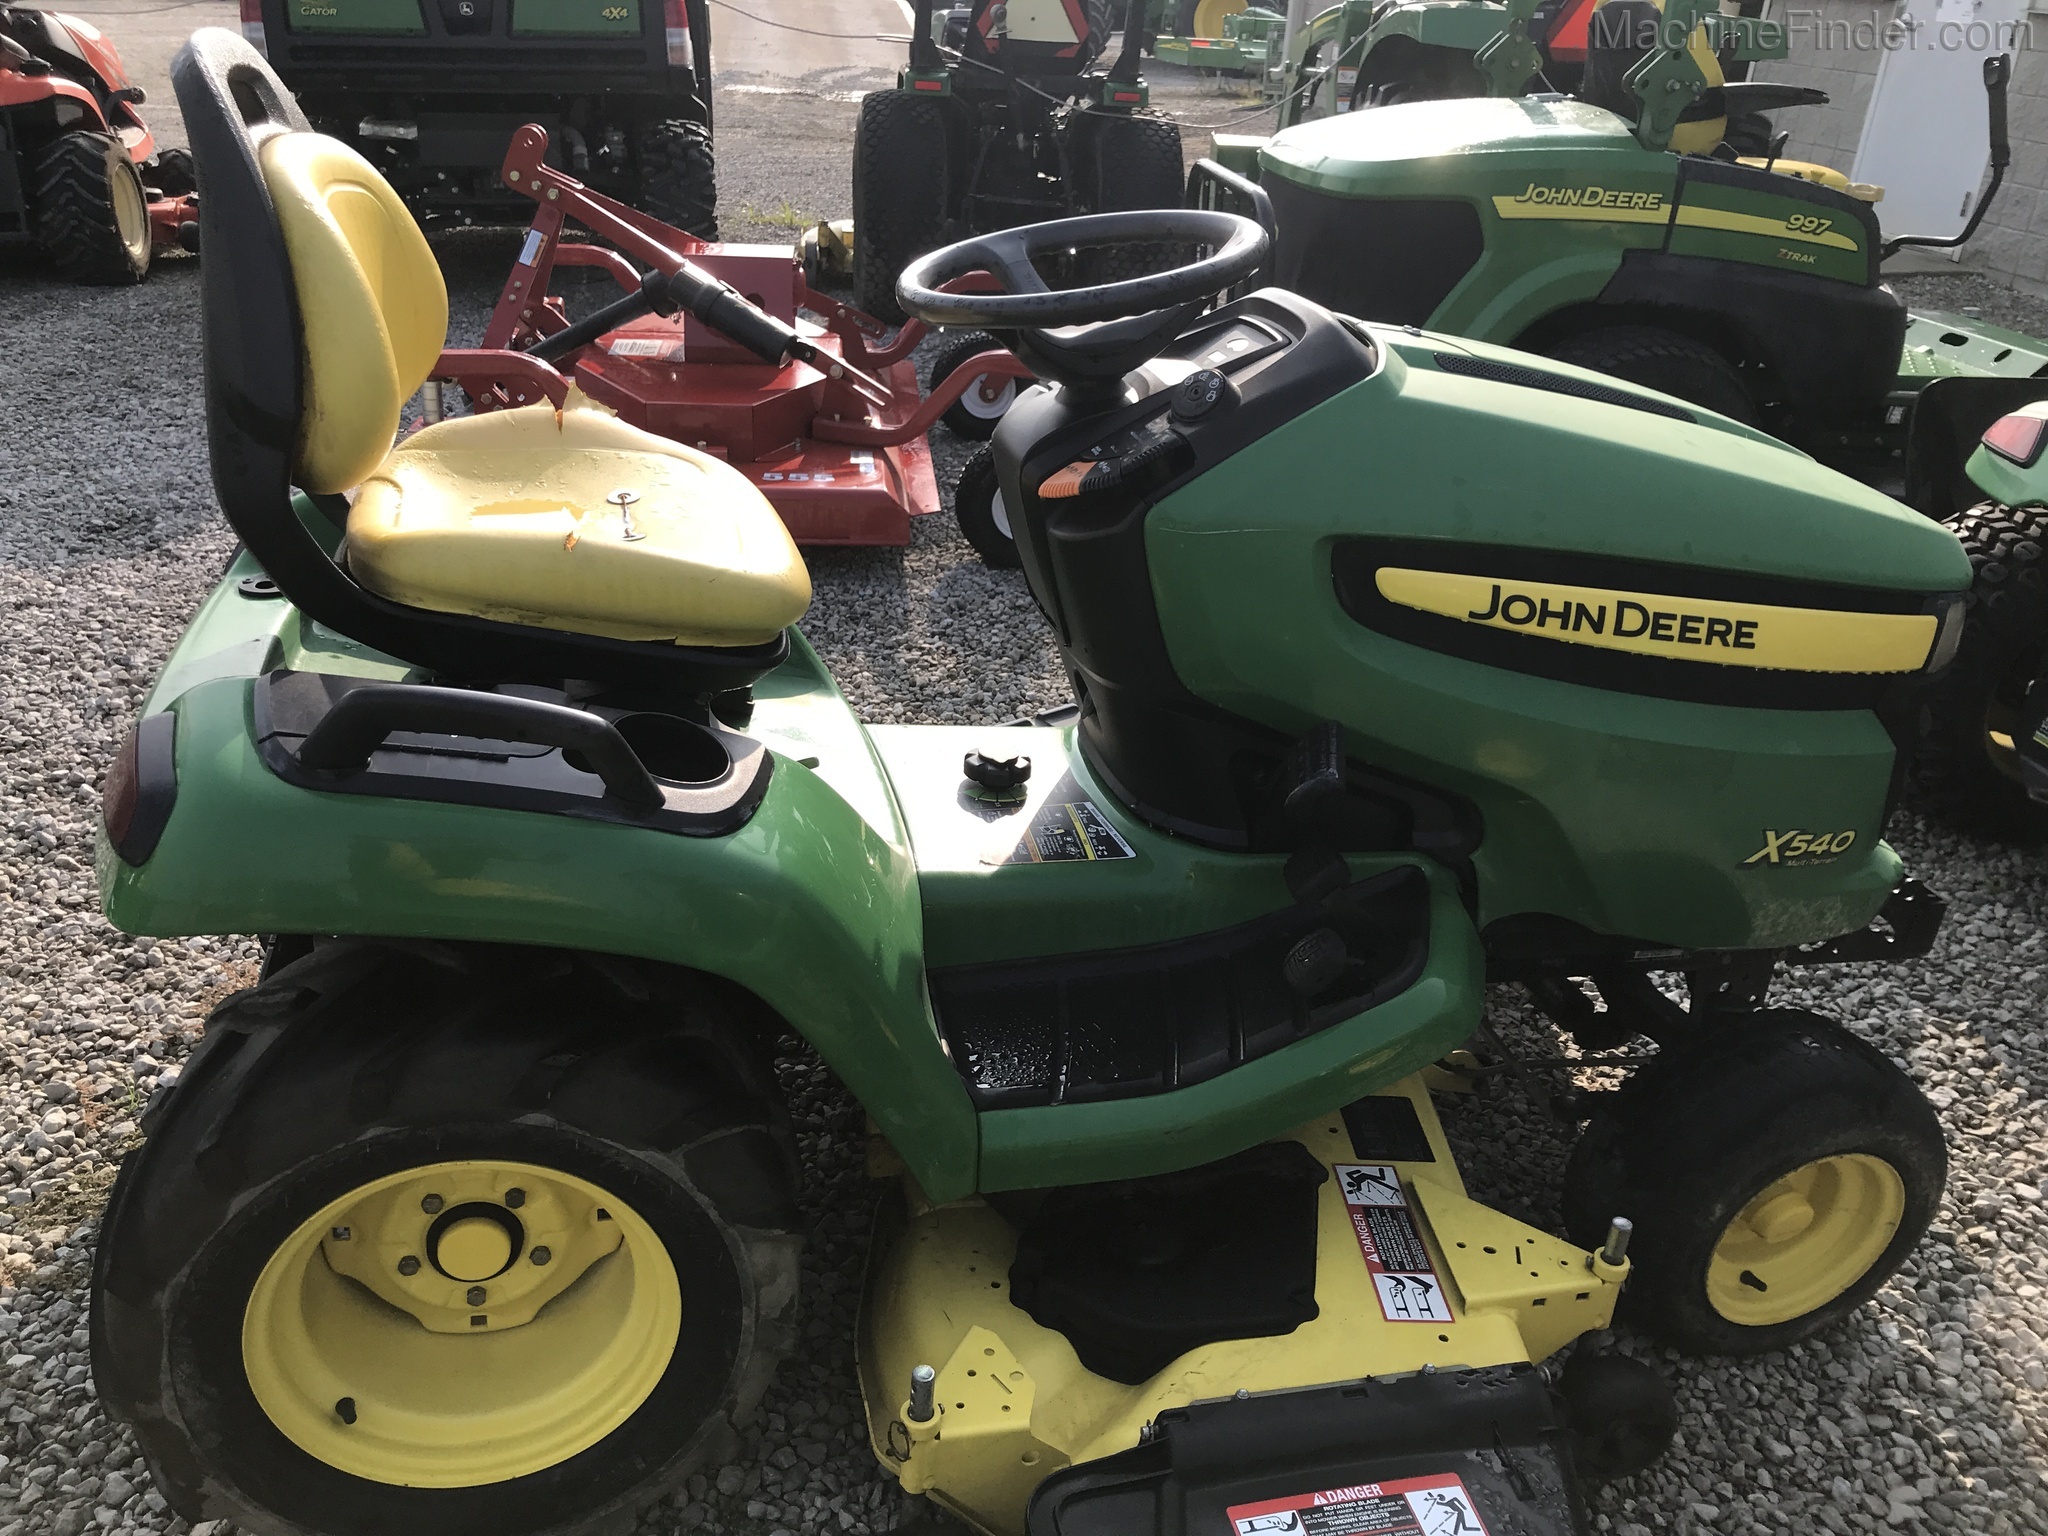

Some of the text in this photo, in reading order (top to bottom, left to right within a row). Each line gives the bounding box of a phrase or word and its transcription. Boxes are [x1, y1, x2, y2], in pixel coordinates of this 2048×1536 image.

[1515, 182, 1663, 211] JOHN DEERE
[1786, 213, 1833, 235] 997
[1468, 585, 1758, 649] JOHN DEERE
[1743, 830, 1856, 863] X540
[1353, 1213, 1375, 1252] DANGER
[1323, 1498, 1380, 1511] ROTATING BLADE
[1325, 1484, 1383, 1503] DANGER
[1328, 1512, 1390, 1526] THROWN OBJECTS
